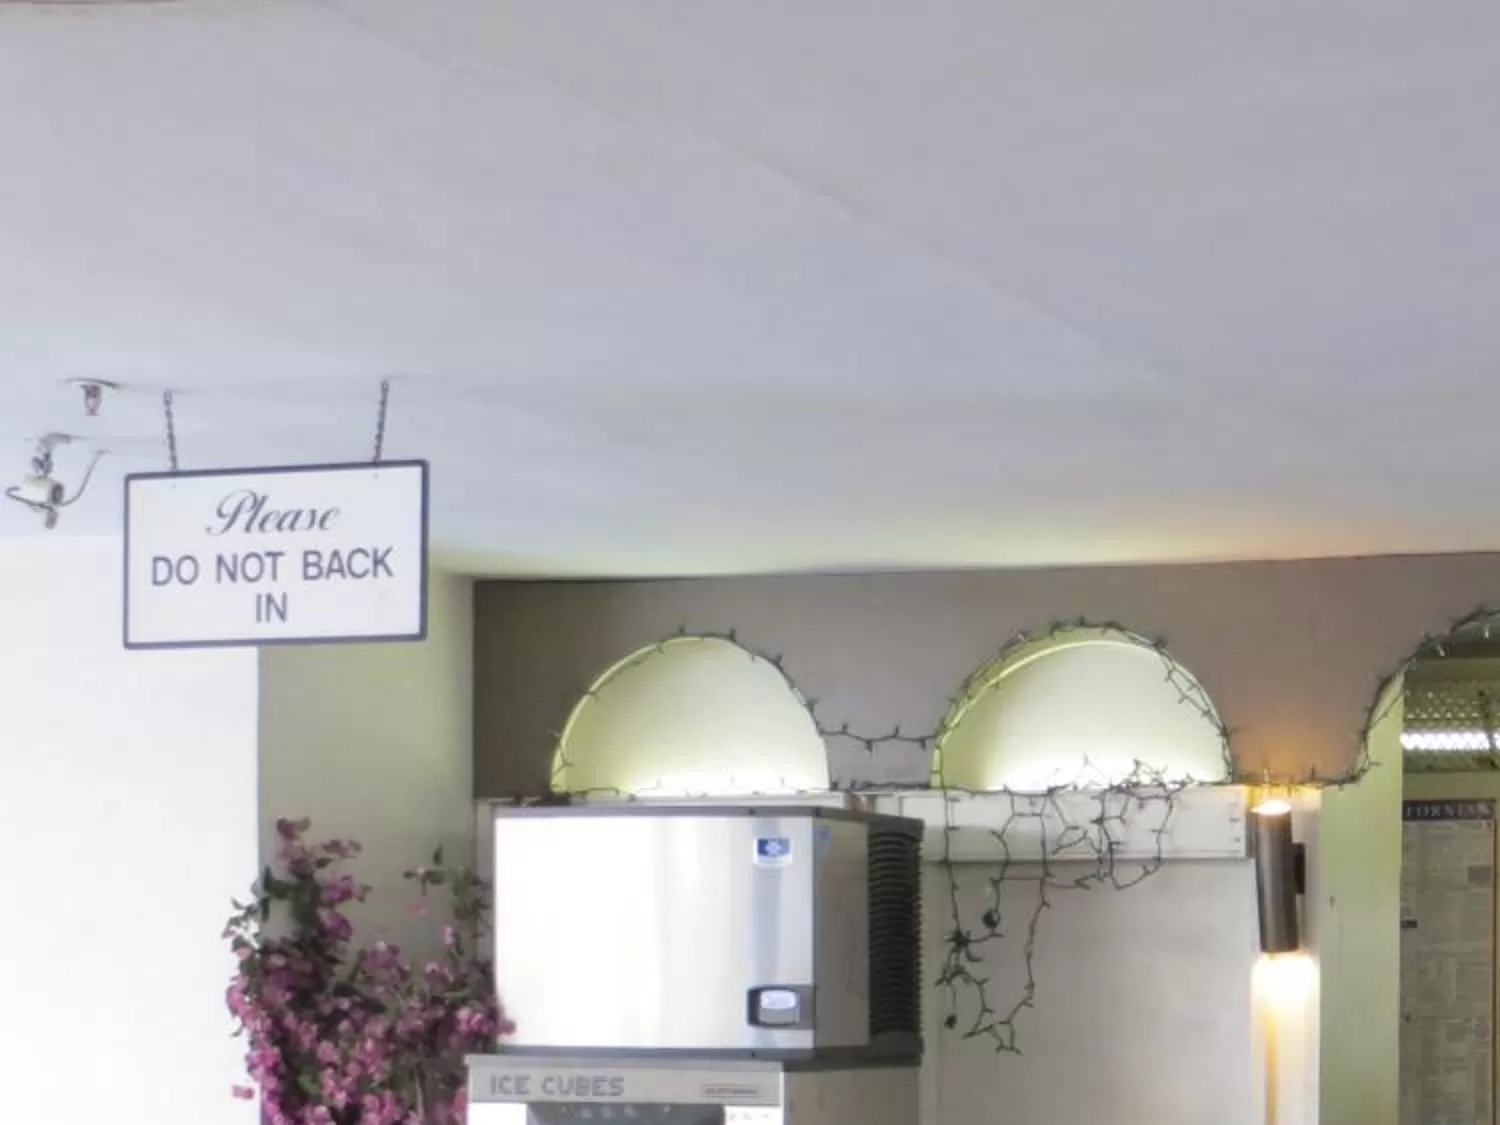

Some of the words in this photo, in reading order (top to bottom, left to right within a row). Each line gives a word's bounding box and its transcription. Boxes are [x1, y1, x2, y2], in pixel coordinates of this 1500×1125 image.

[205, 488, 341, 536] Please
[151, 555, 200, 587] DO
[216, 551, 286, 584] NOT
[302, 546, 395, 581] BACK
[255, 592, 288, 623] IN
[489, 1075, 532, 1096] ICE
[541, 1075, 626, 1097] CUBES
